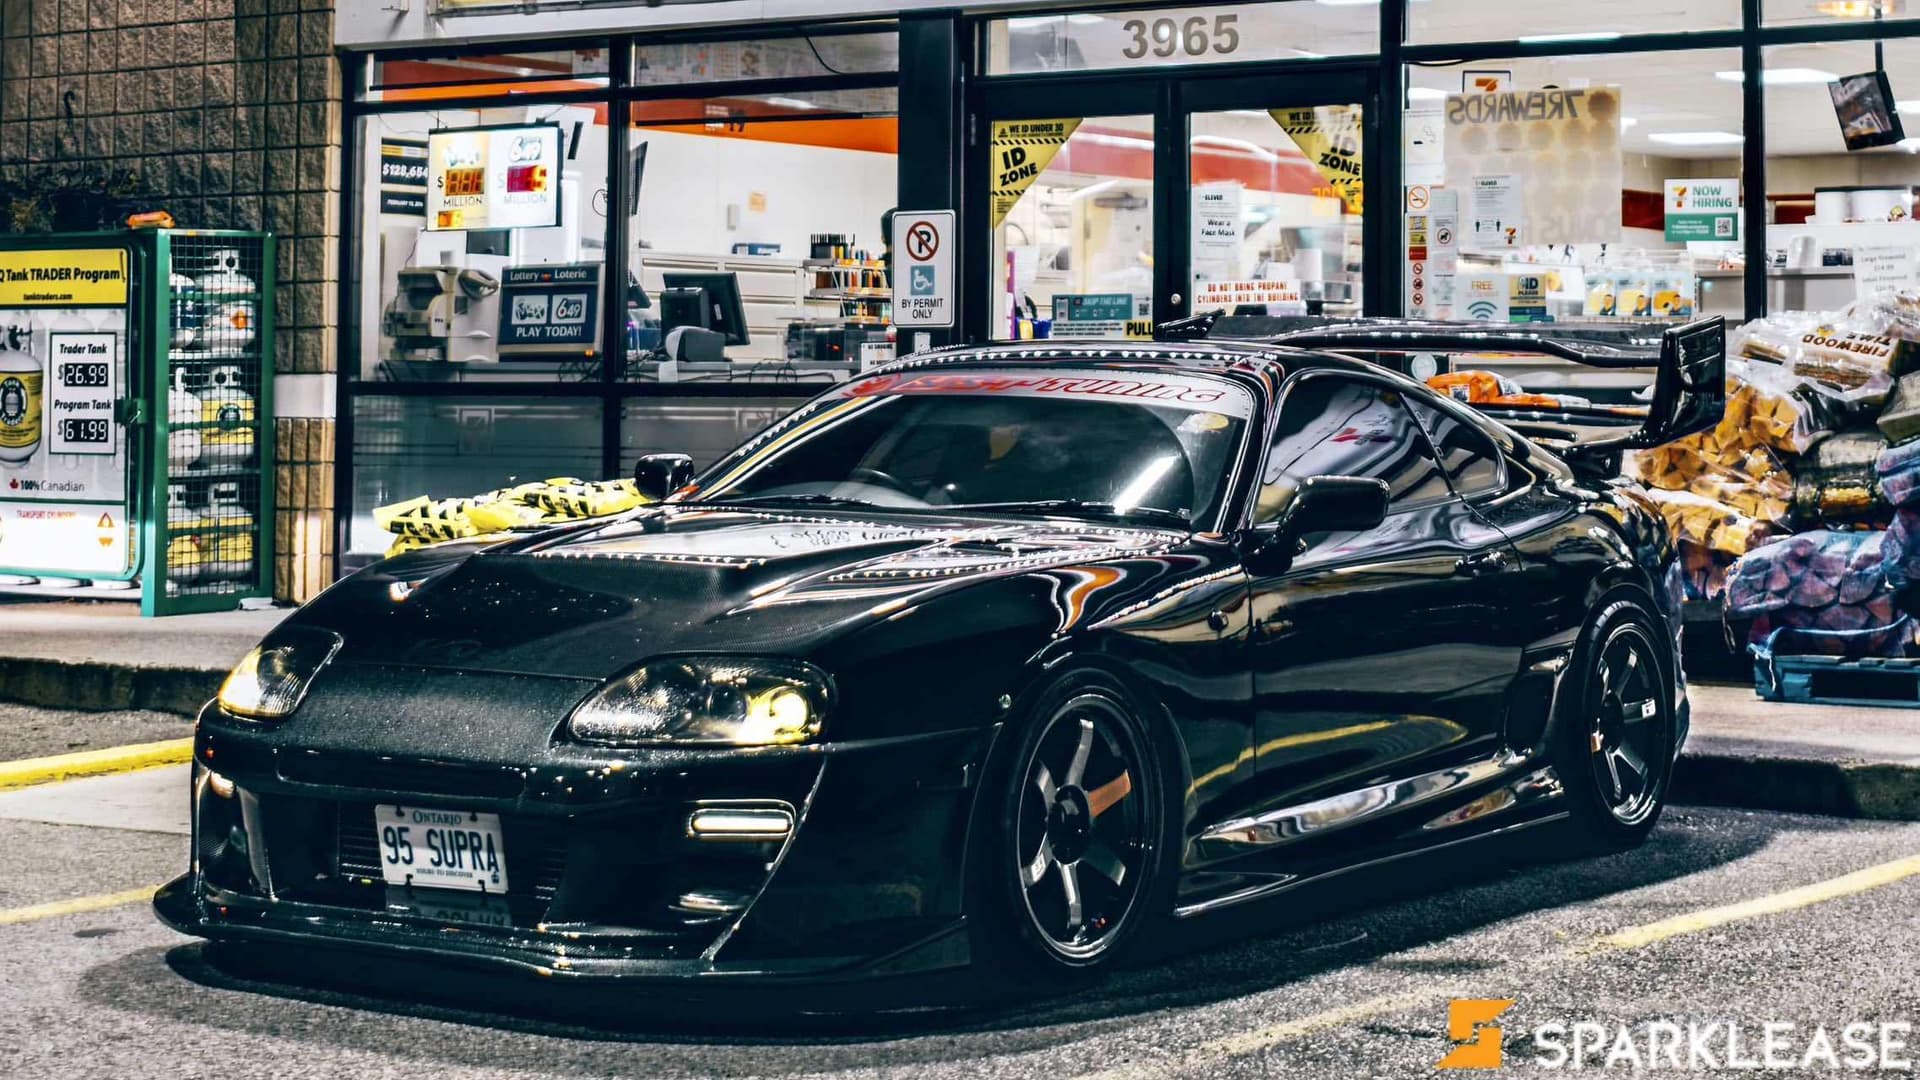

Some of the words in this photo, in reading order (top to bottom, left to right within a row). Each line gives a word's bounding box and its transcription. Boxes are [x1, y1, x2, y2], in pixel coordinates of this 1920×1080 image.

[1122, 14, 1239, 59] 3965
[1009, 125, 1019, 133] WE
[1021, 124, 1029, 132] ID
[1030, 124, 1053, 133] UNDER
[1330, 134, 1357, 157] ID
[1002, 147, 1026, 170] ID
[1319, 153, 1361, 176] ZONE
[999, 162, 1038, 187] ZONE
[1692, 186, 1722, 197] NOW
[443, 196, 483, 208] MILLION
[1692, 197, 1733, 208] HIRING
[6, 268, 29, 281] Tank
[30, 267, 72, 281] TRADER
[73, 267, 120, 283] Program
[510, 271, 540, 281] Lottery
[555, 269, 587, 279] Loterie
[1471, 281, 1494, 290] FREE
[901, 299, 911, 308] BY
[913, 298, 944, 308] PERMIT
[1197, 295, 1232, 304] CYLINDERS
[1267, 293, 1298, 301] BUILDING
[912, 309, 933, 319] ONLY
[516, 327, 541, 337] PLAY
[545, 326, 582, 337] TODAY!
[1126, 321, 1153, 337] PULL
[59, 344, 86, 354] Trader
[87, 344, 107, 354] Tank
[1802, 334, 1890, 357] FIREWOOD
[54, 399, 90, 412] Program
[92, 399, 112, 410] Tank
[20, 480, 40, 491] 100%
[40, 480, 85, 492] Canadian
[412, 810, 463, 825] ONTARIO
[383, 826, 414, 865] 95
[426, 828, 500, 873] SUPRA
